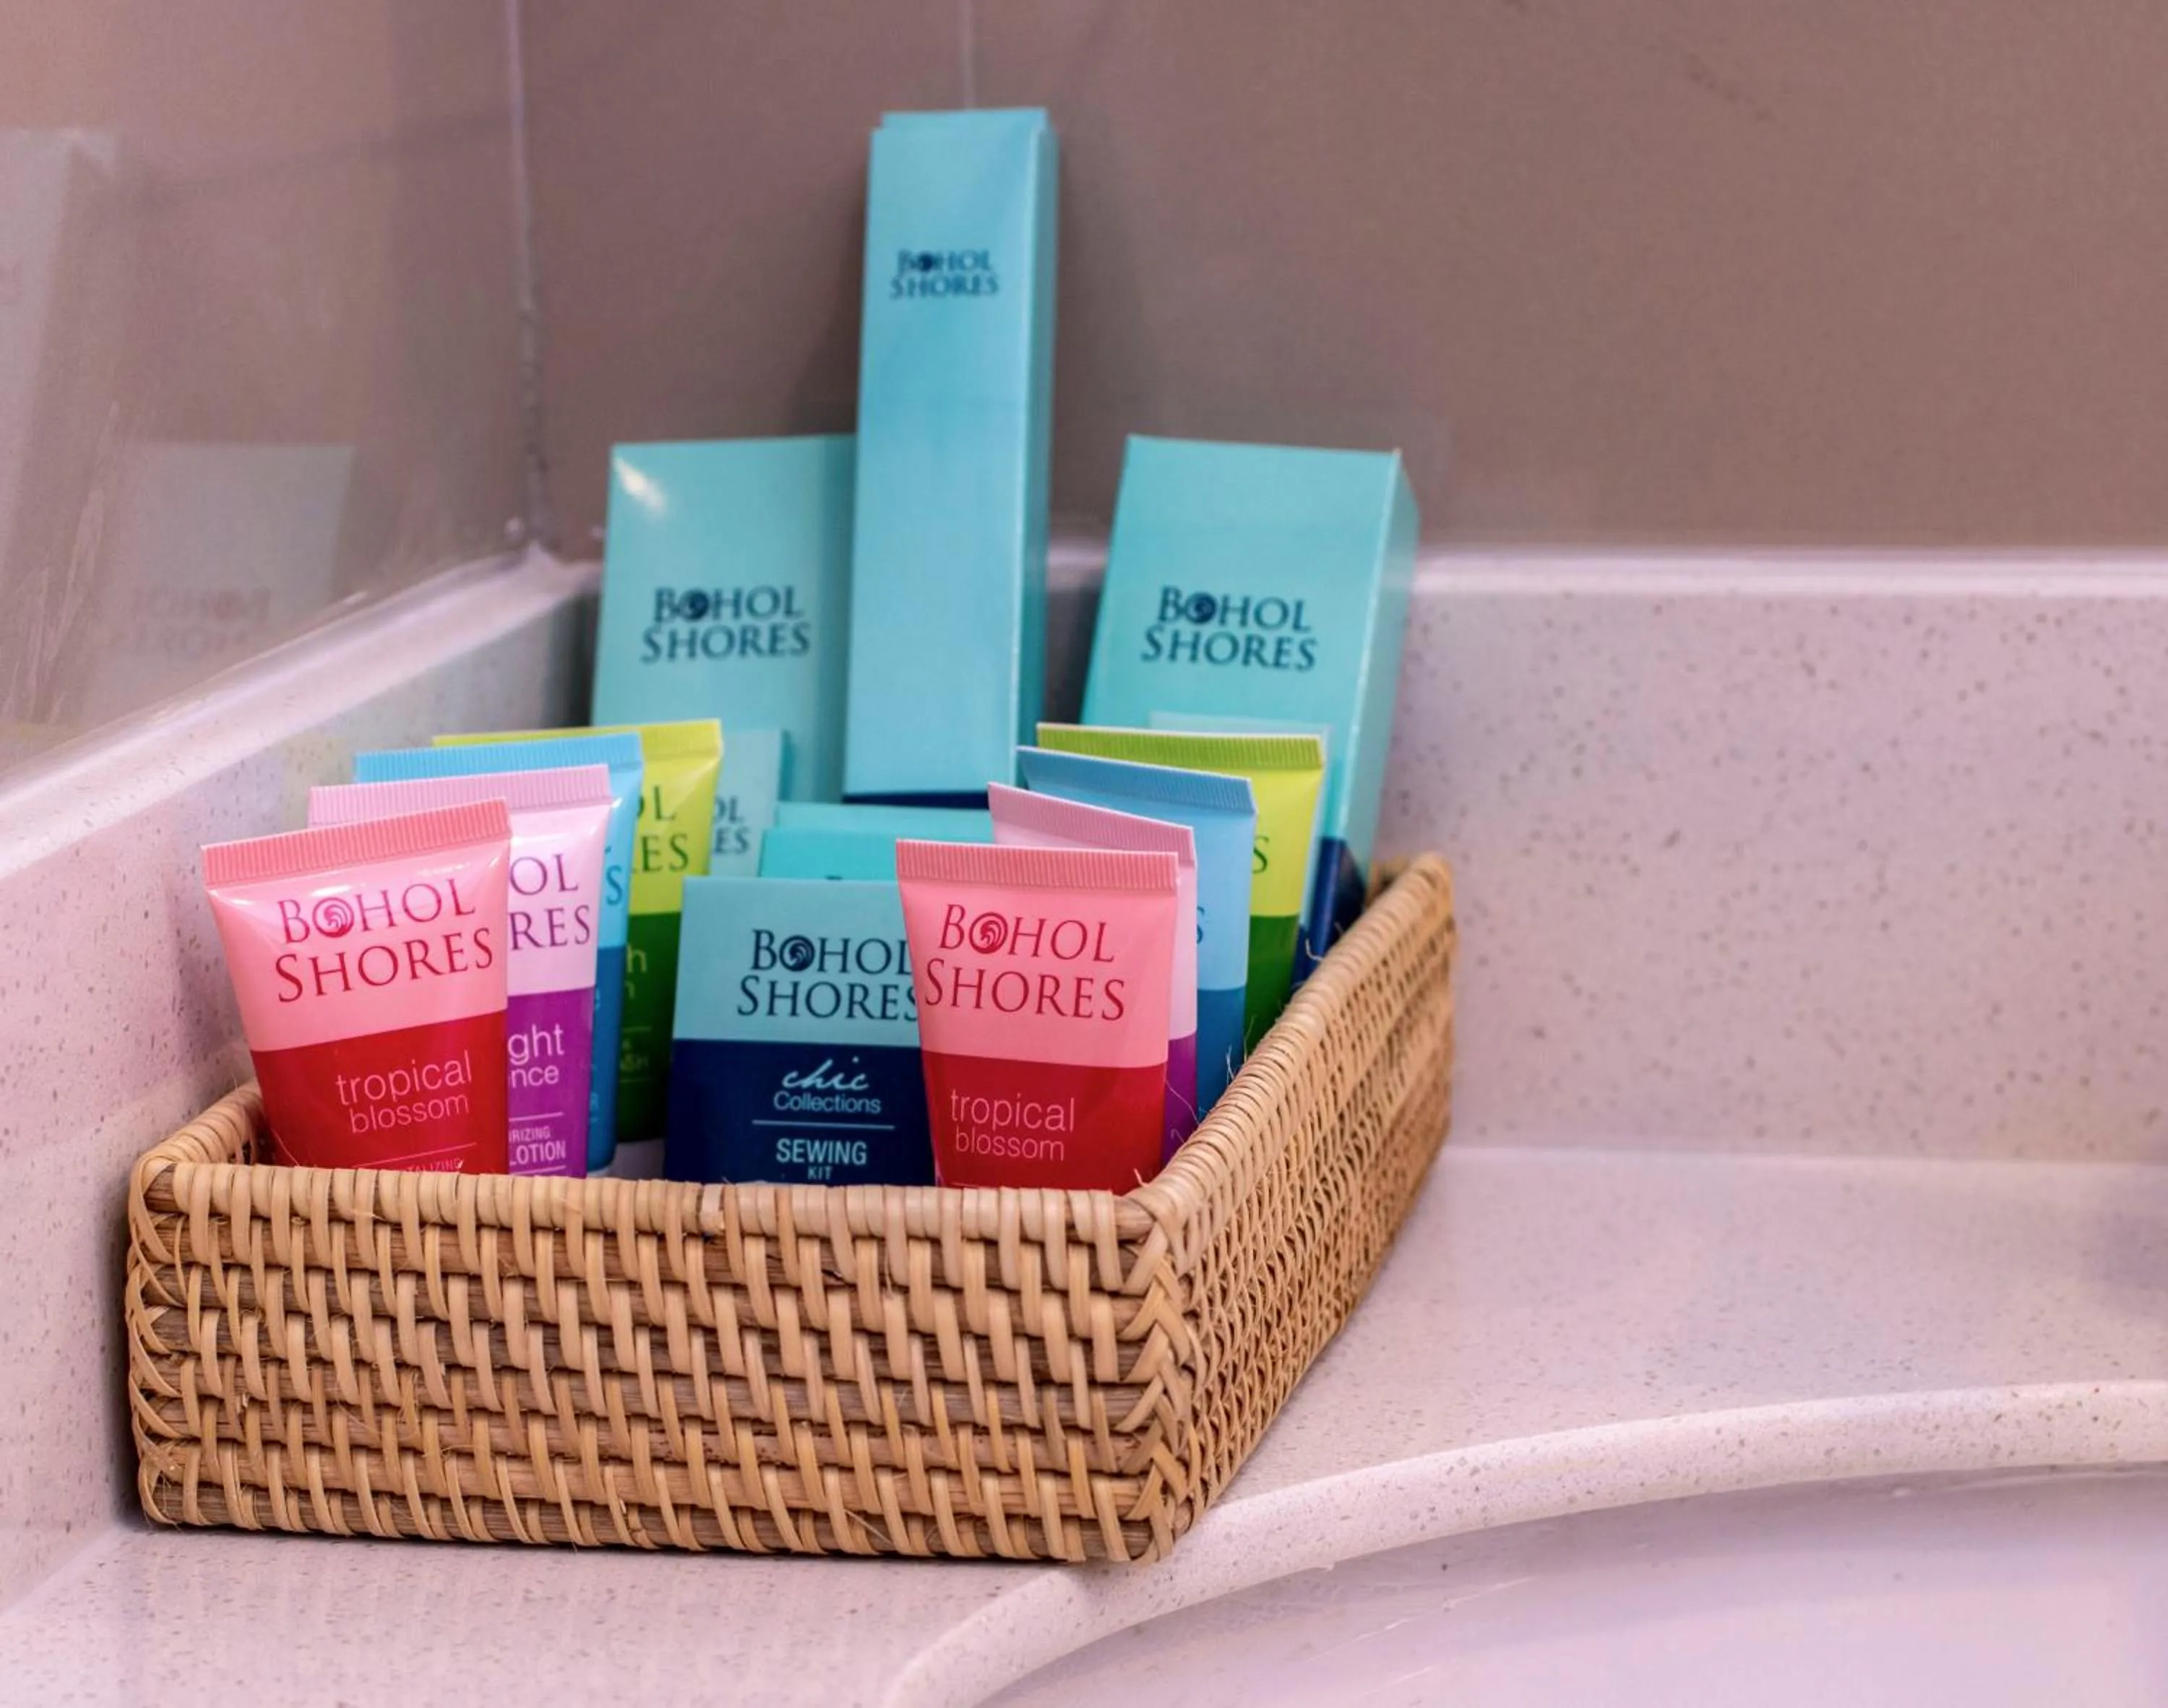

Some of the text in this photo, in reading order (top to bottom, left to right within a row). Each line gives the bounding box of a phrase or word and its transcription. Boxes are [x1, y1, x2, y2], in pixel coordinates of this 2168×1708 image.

[653, 584, 805, 624] BOHOL
[1158, 585, 1312, 634] BOHOL
[640, 621, 811, 666] SHORES
[1140, 624, 1317, 672] SHORES
[278, 878, 476, 944] BOHOL
[939, 903, 1115, 963] BOHOL
[275, 927, 493, 1003] SHORES
[750, 928, 912, 975] BOHOL
[736, 975, 919, 1022] SHORES
[924, 957, 1125, 1022] SHORES
[335, 1050, 472, 1106] tropical
[781, 1056, 869, 1091] chic
[349, 1095, 470, 1134] blossom
[773, 1090, 882, 1114] Collections
[950, 1088, 1075, 1132] tropical
[775, 1137, 868, 1165] SEWING
[955, 1125, 1064, 1162] blossom
[807, 1165, 833, 1181] KIT
